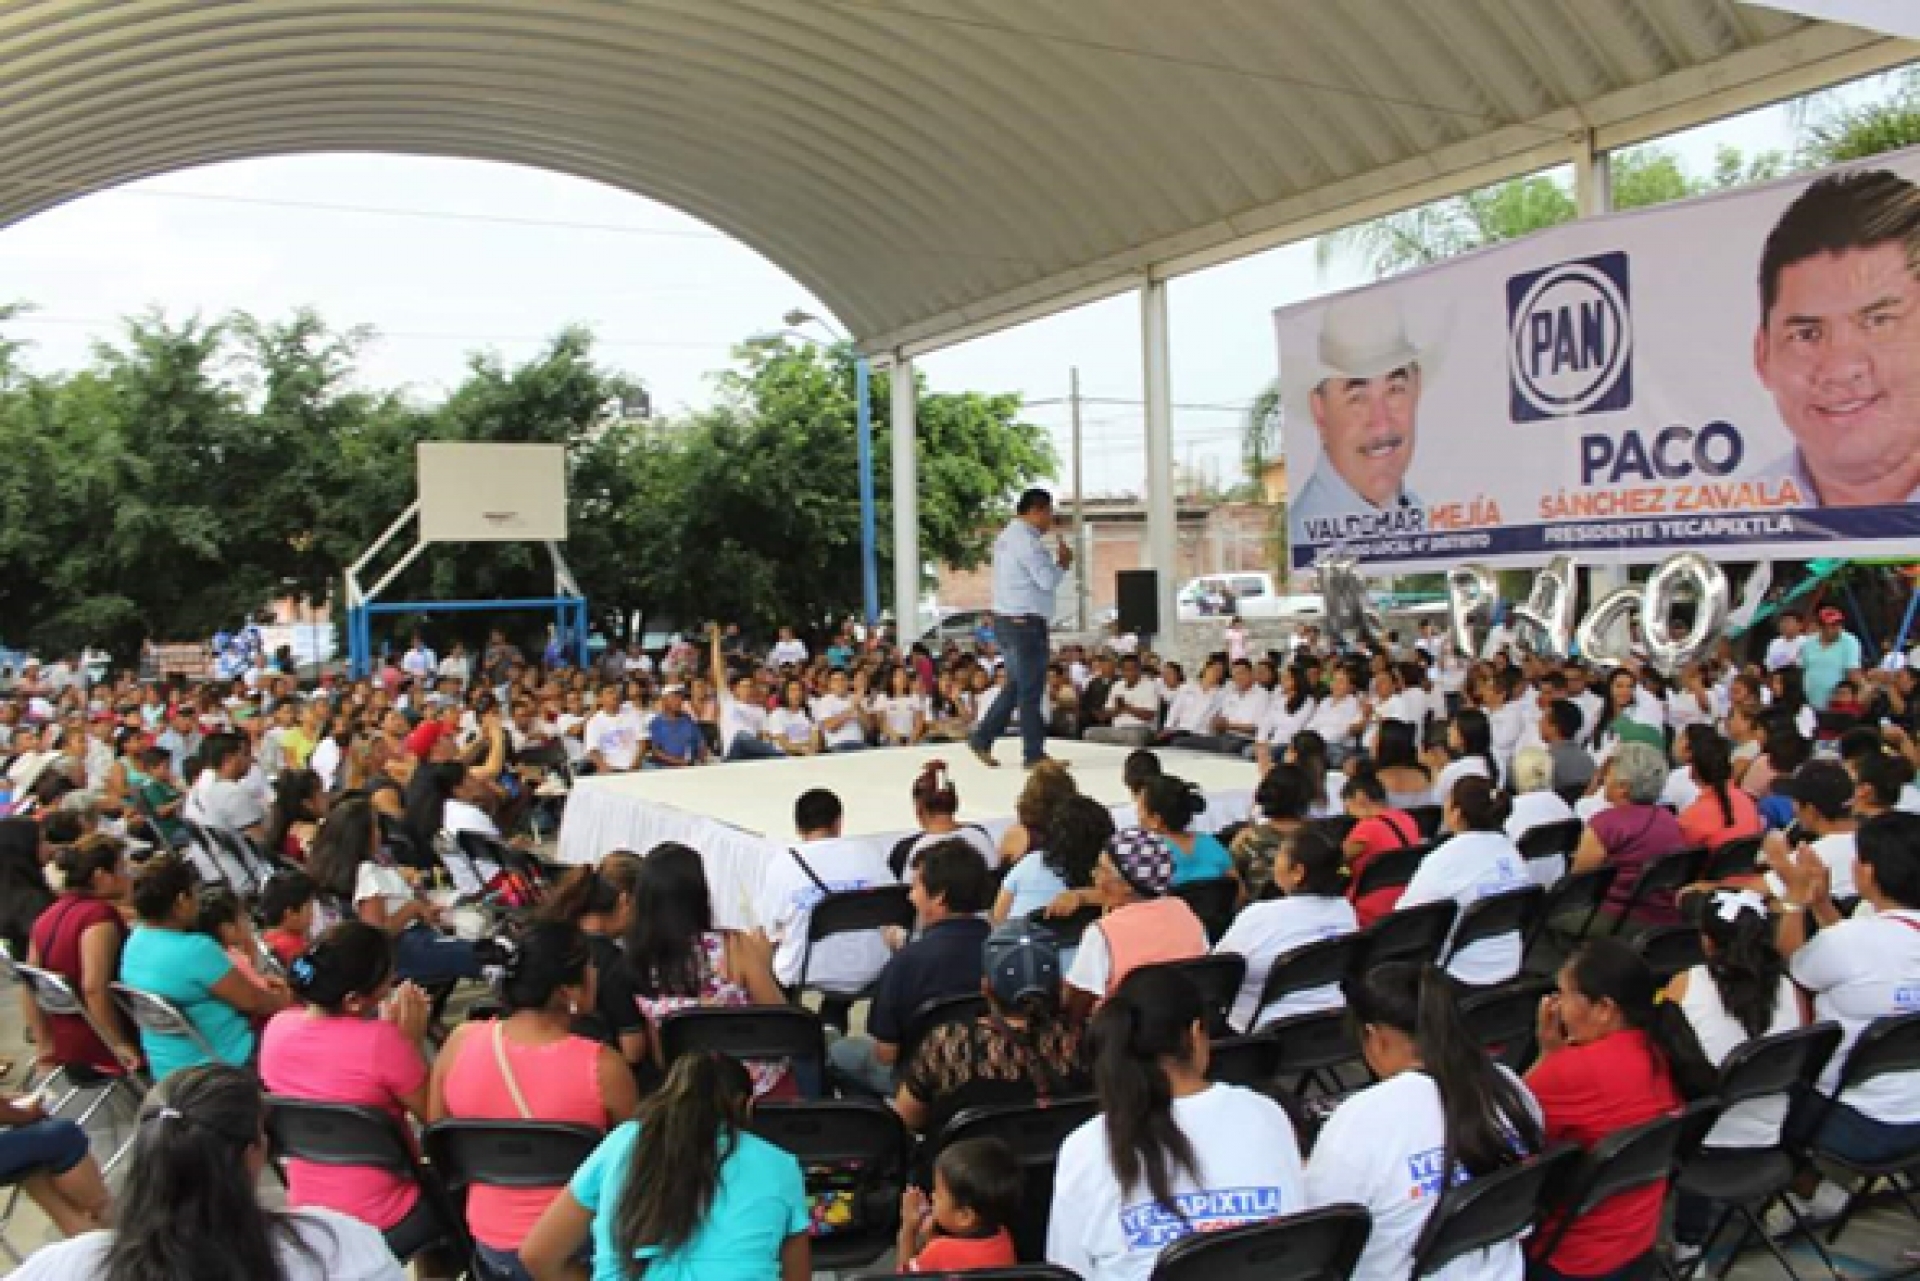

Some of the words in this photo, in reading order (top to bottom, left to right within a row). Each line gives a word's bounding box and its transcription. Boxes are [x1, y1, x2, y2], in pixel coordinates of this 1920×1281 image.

[1530, 301, 1605, 379] PAN
[1580, 420, 1744, 486] PACO
[1304, 508, 1424, 541] VALDEMAR
[1428, 493, 1501, 532] MEJÍA
[1538, 486, 1666, 519] SÁNCHEZ
[1674, 479, 1801, 511] ZAVALA
[1544, 521, 1655, 542] PRESIDENTE
[1658, 514, 1794, 538] YECAPIXTLA
